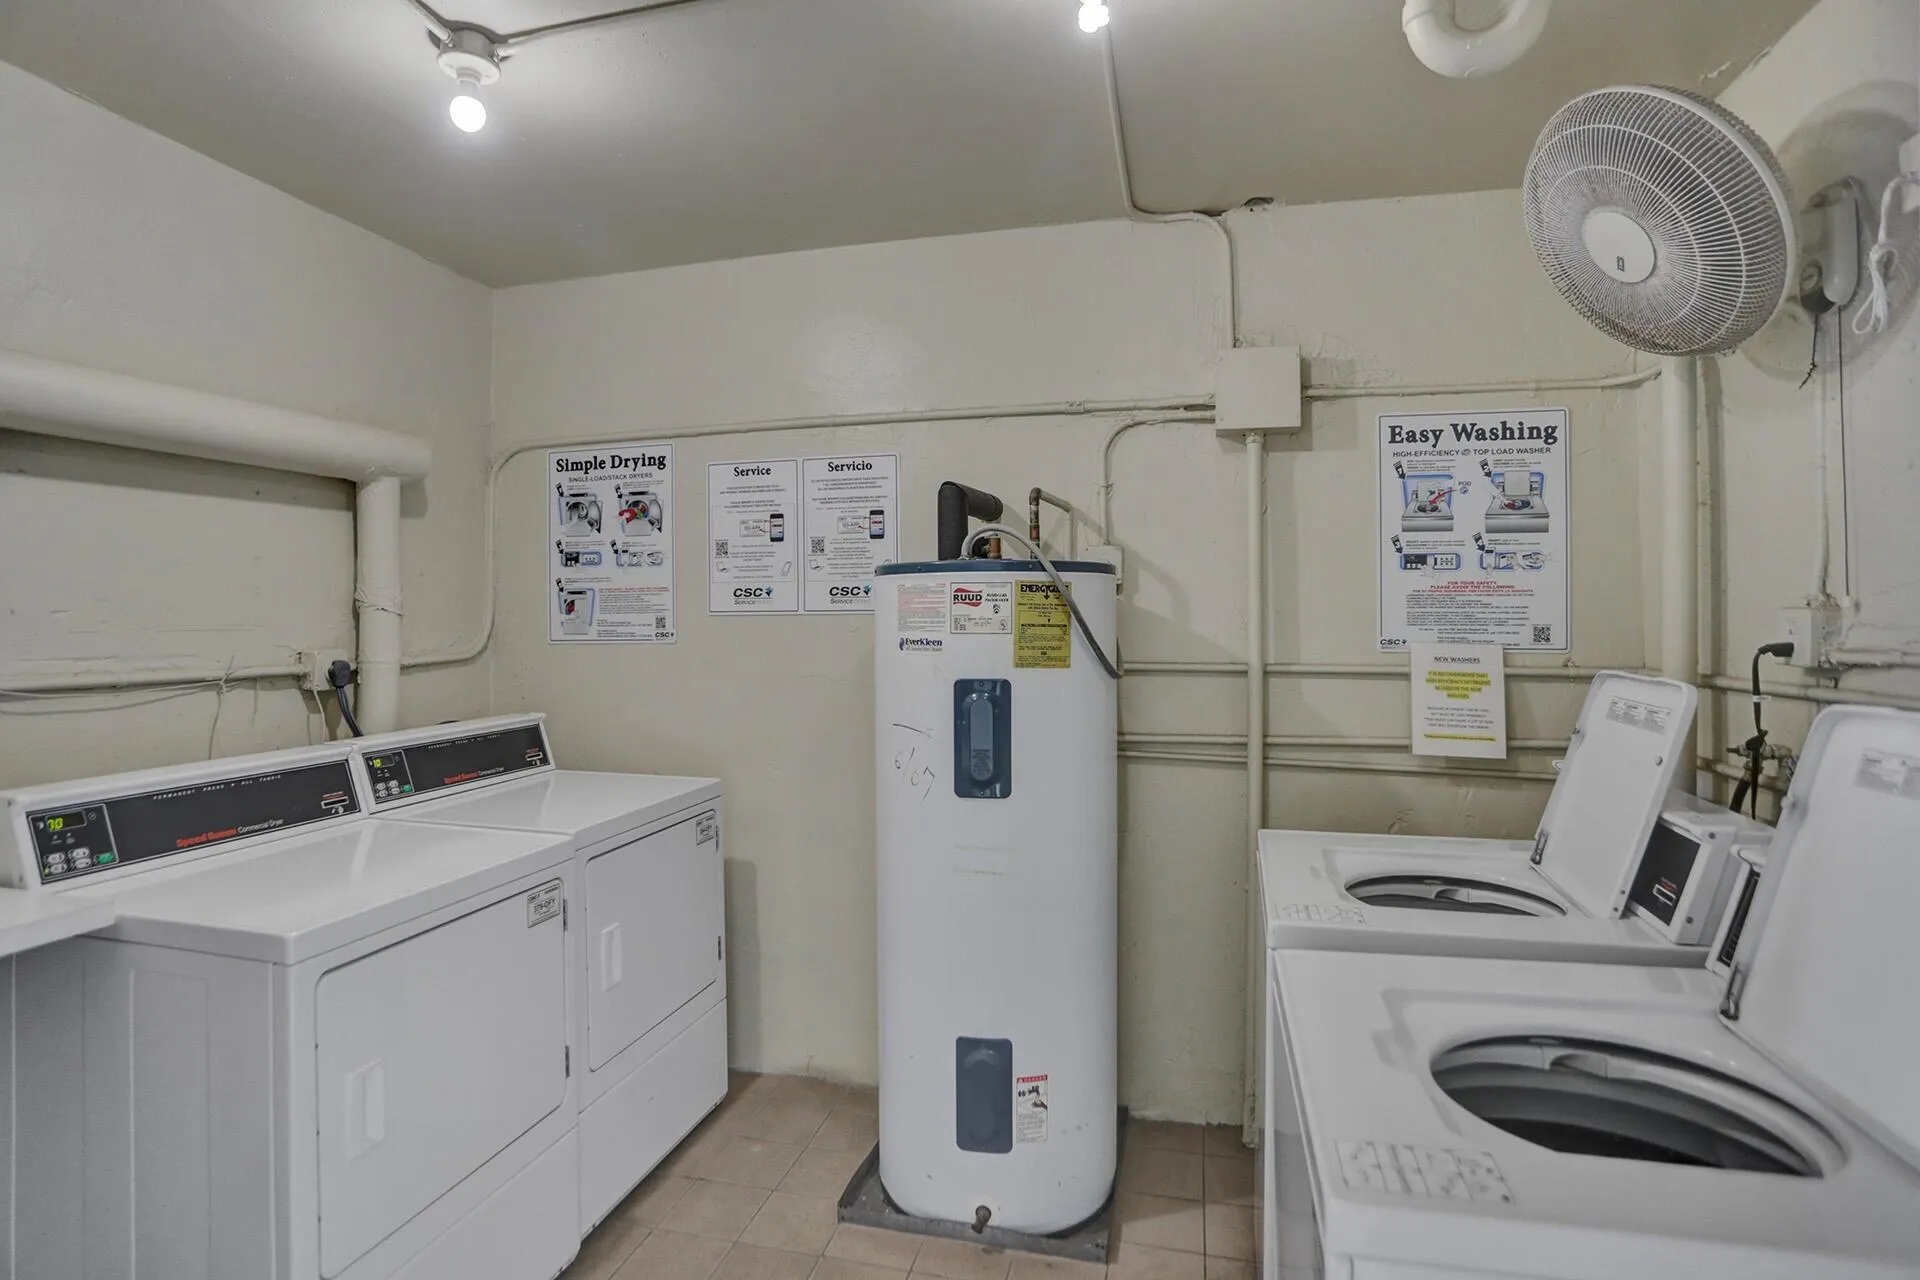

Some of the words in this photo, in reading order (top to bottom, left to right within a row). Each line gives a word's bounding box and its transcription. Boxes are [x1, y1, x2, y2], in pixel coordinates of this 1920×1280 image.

[1388, 425, 1444, 448] Easy
[1450, 421, 1558, 445] Washing
[1393, 449, 1460, 457] HIGH-EFFICIENCY
[1473, 448, 1490, 456] TOP
[1516, 447, 1552, 455] WASHER
[556, 456, 606, 474] Simple
[610, 453, 666, 471] Drying
[828, 460, 872, 472] Servicio
[734, 466, 771, 477] Service
[733, 588, 763, 598] CSC
[829, 586, 861, 597] CSC
[953, 593, 982, 602] RUUD
[905, 637, 943, 647] EverKleen
[1450, 656, 1480, 664] WASHERS
